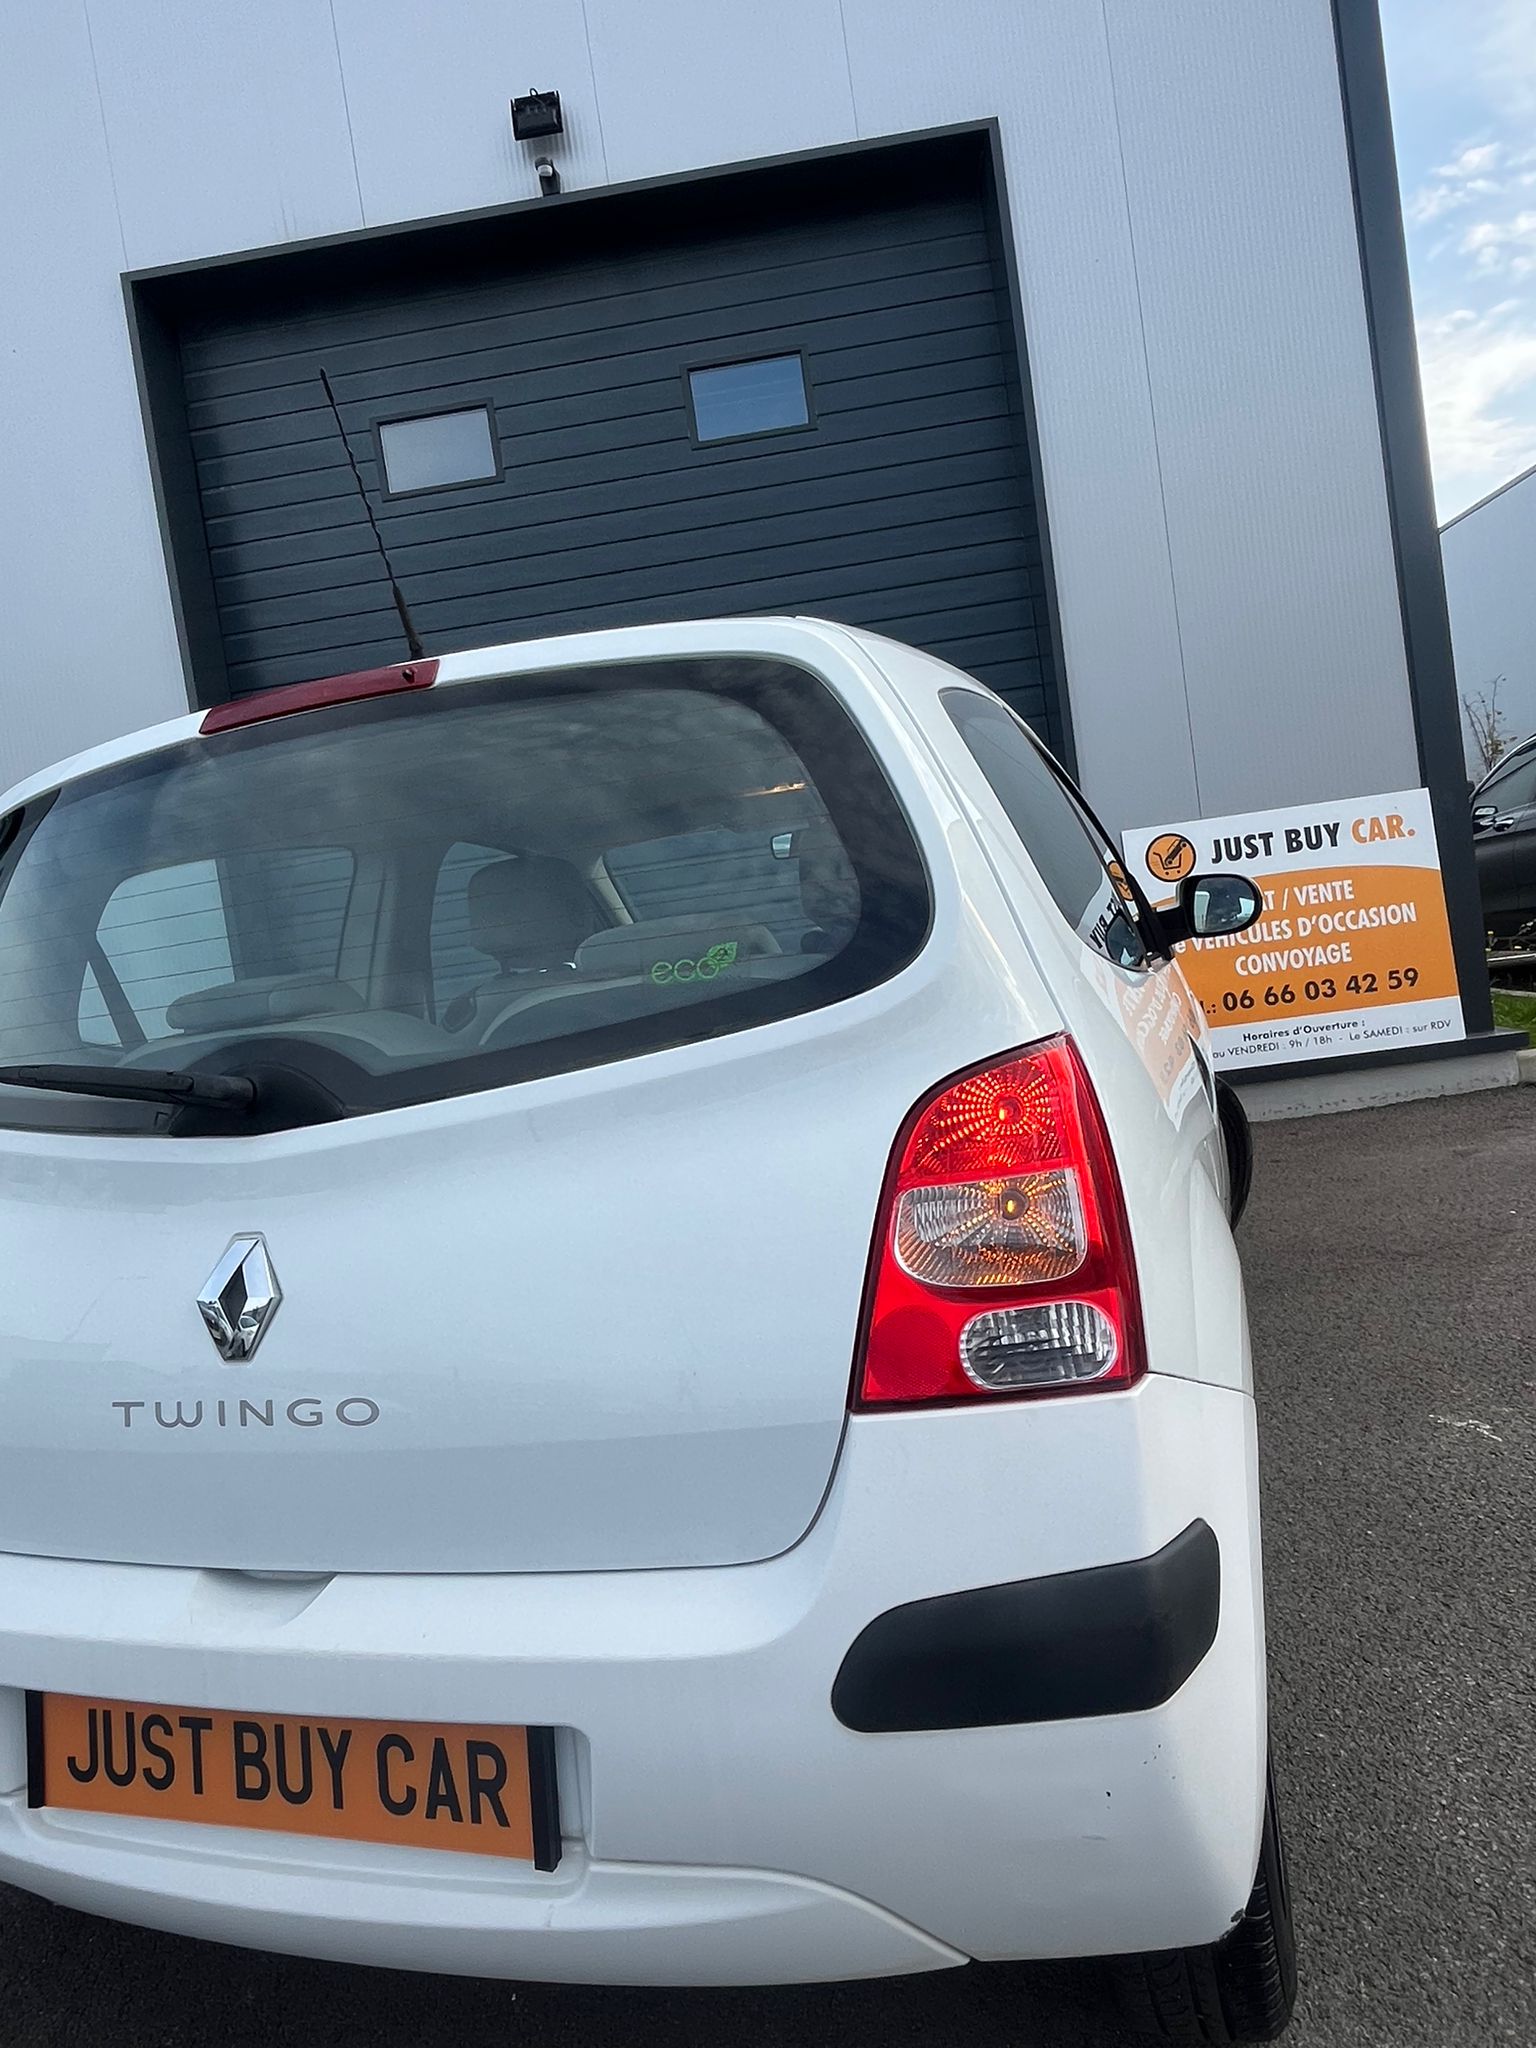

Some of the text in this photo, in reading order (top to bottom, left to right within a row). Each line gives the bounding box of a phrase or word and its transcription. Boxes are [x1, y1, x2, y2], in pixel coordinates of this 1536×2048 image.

[1211, 813, 1416, 865] JUST BUY CAR.
[1282, 887, 1289, 911] /
[1293, 879, 1355, 907] VENTE
[1297, 901, 1417, 938] D'OCCASION
[651, 957, 720, 985] eco
[1234, 941, 1353, 977] CONVOYAGE
[1222, 989, 1256, 1012] 06
[1263, 983, 1297, 1007] 66
[1304, 977, 1337, 1001] 03
[1345, 973, 1379, 995] 42
[1387, 967, 1419, 990] 59
[1227, 1042, 1280, 1057] VENDREDI
[1289, 1037, 1303, 1049] 9h
[1313, 1035, 1333, 1046] 18h
[1363, 1025, 1404, 1039] SAMEDI
[1412, 1023, 1429, 1032] sur
[1430, 1019, 1452, 1030] RDV
[1242, 1028, 1290, 1042] Horaires
[1292, 1020, 1359, 1036] d'Ouverture
[111, 1396, 381, 1429] TWINGO
[66, 1708, 512, 1829] JUST BUY CAR
